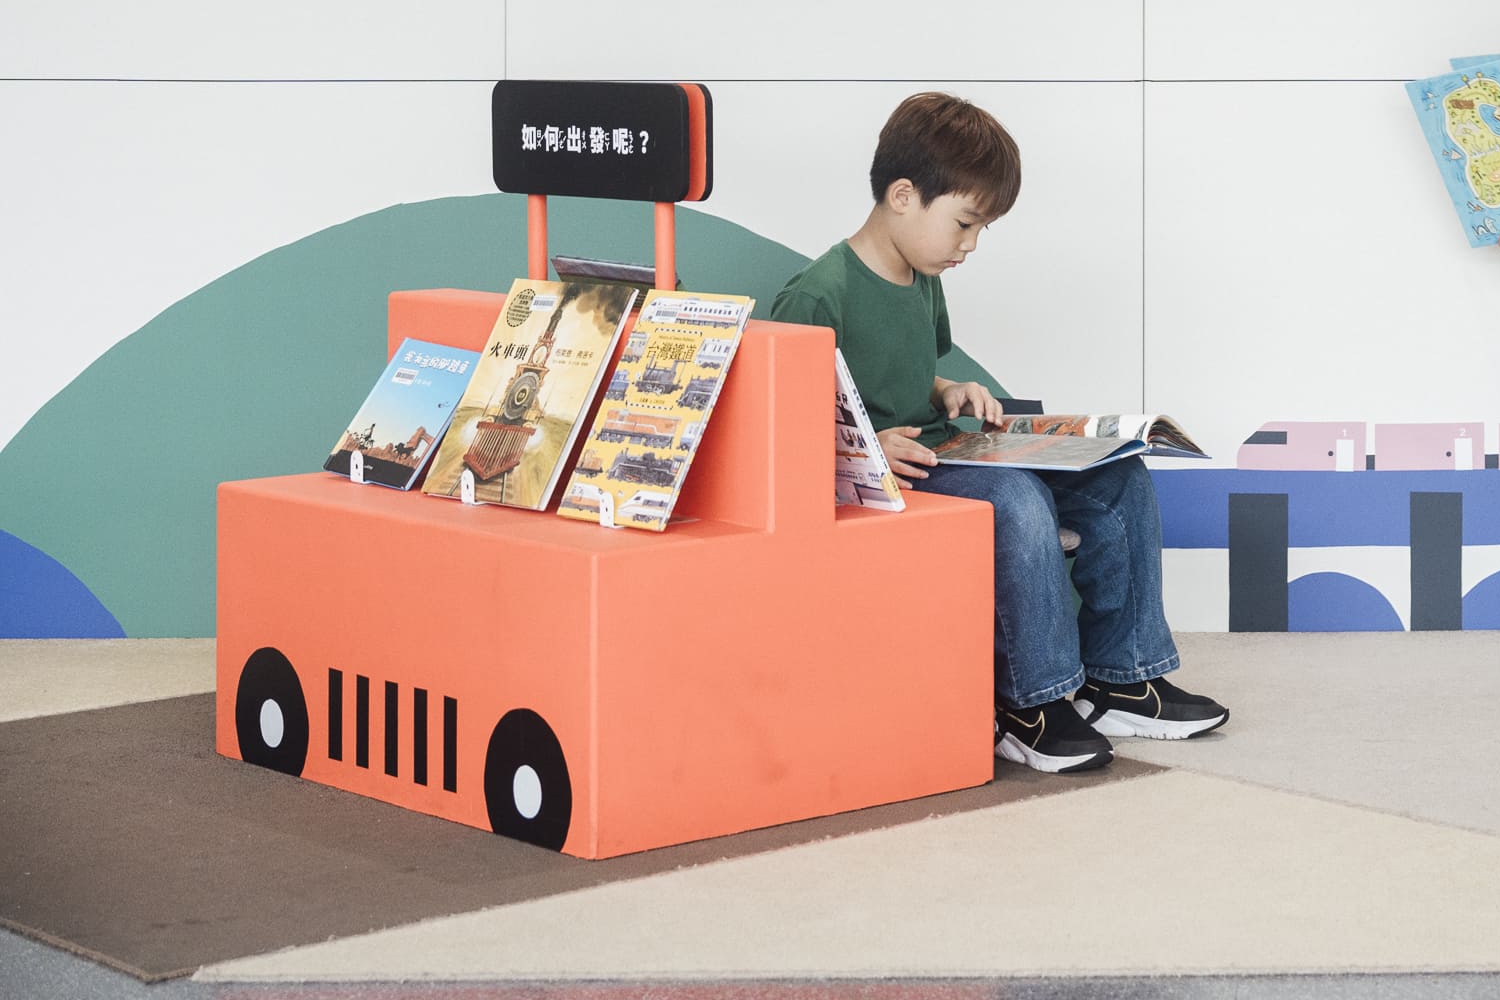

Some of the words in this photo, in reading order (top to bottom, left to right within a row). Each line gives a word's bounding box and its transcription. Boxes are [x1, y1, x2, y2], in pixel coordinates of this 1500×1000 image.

[521, 124, 649, 154] 如何出發呢？
[488, 341, 529, 361] 火車頭
